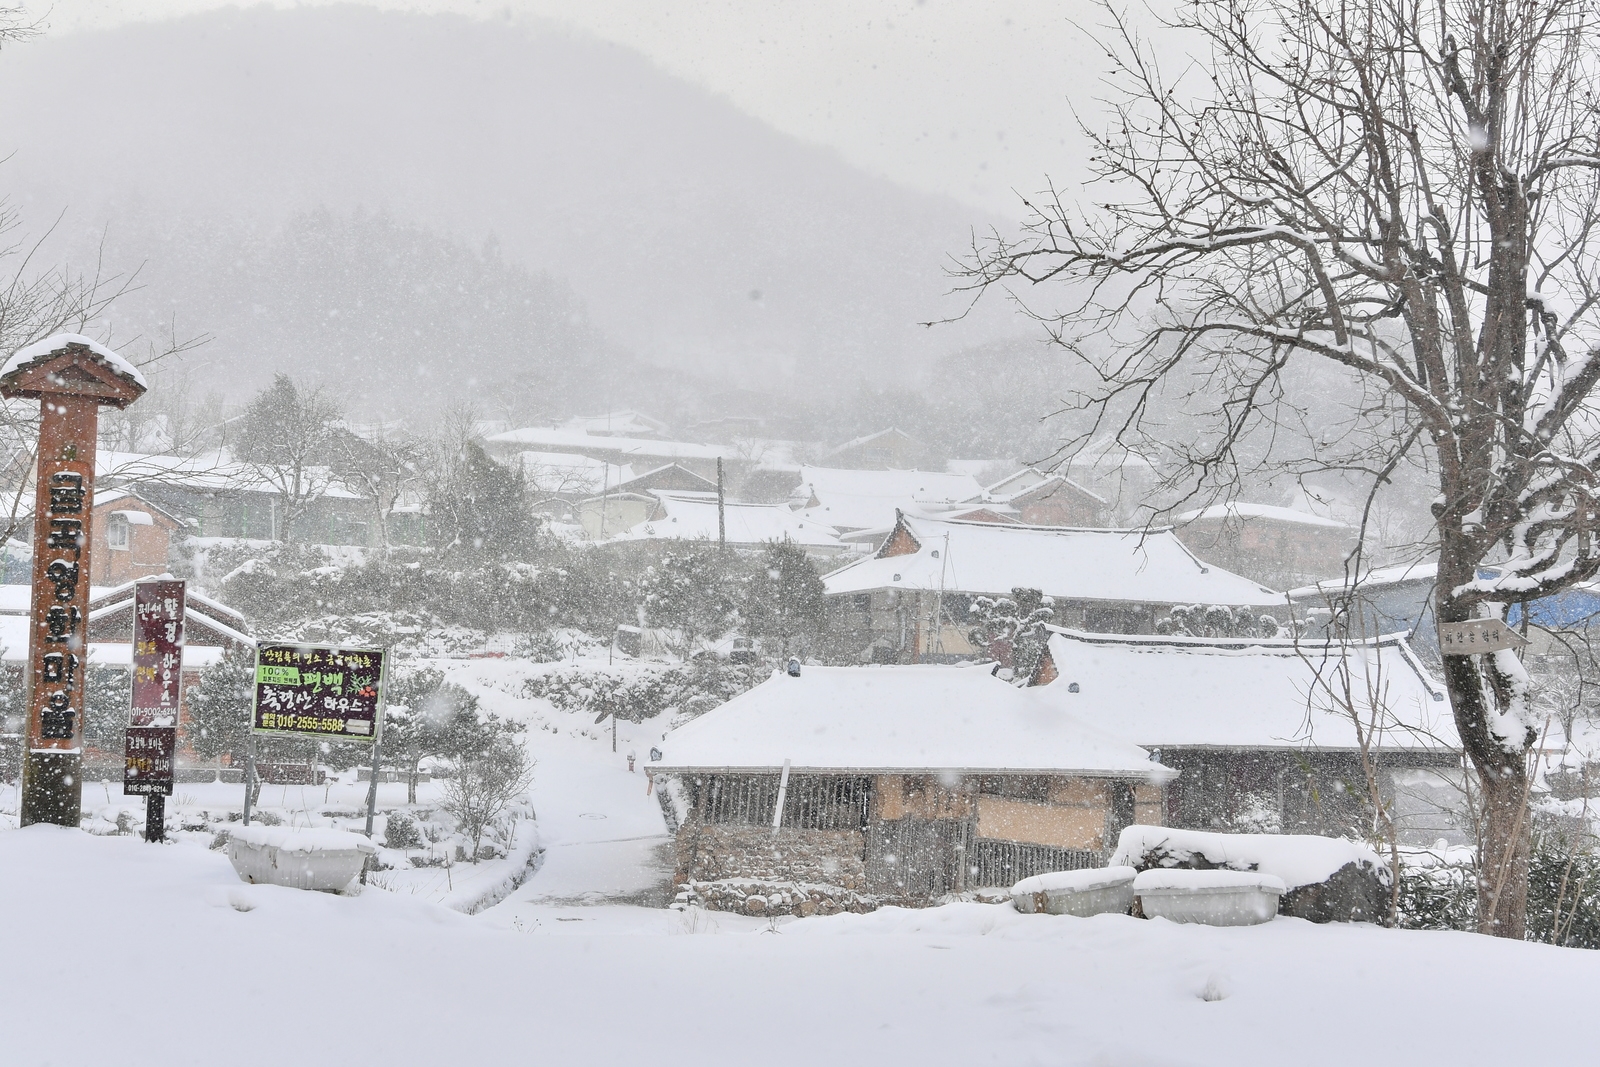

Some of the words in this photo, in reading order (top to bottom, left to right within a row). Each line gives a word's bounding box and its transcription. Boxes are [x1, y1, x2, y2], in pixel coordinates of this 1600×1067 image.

[41, 470, 86, 739] 금곡영화마을
[264, 649, 301, 664] 산림욕의
[160, 653, 176, 706] 하우스
[262, 667, 290, 676] 100%
[301, 671, 344, 696] 편백
[323, 697, 363, 713] 하우스
[277, 715, 343, 732] 010-2555-5588
